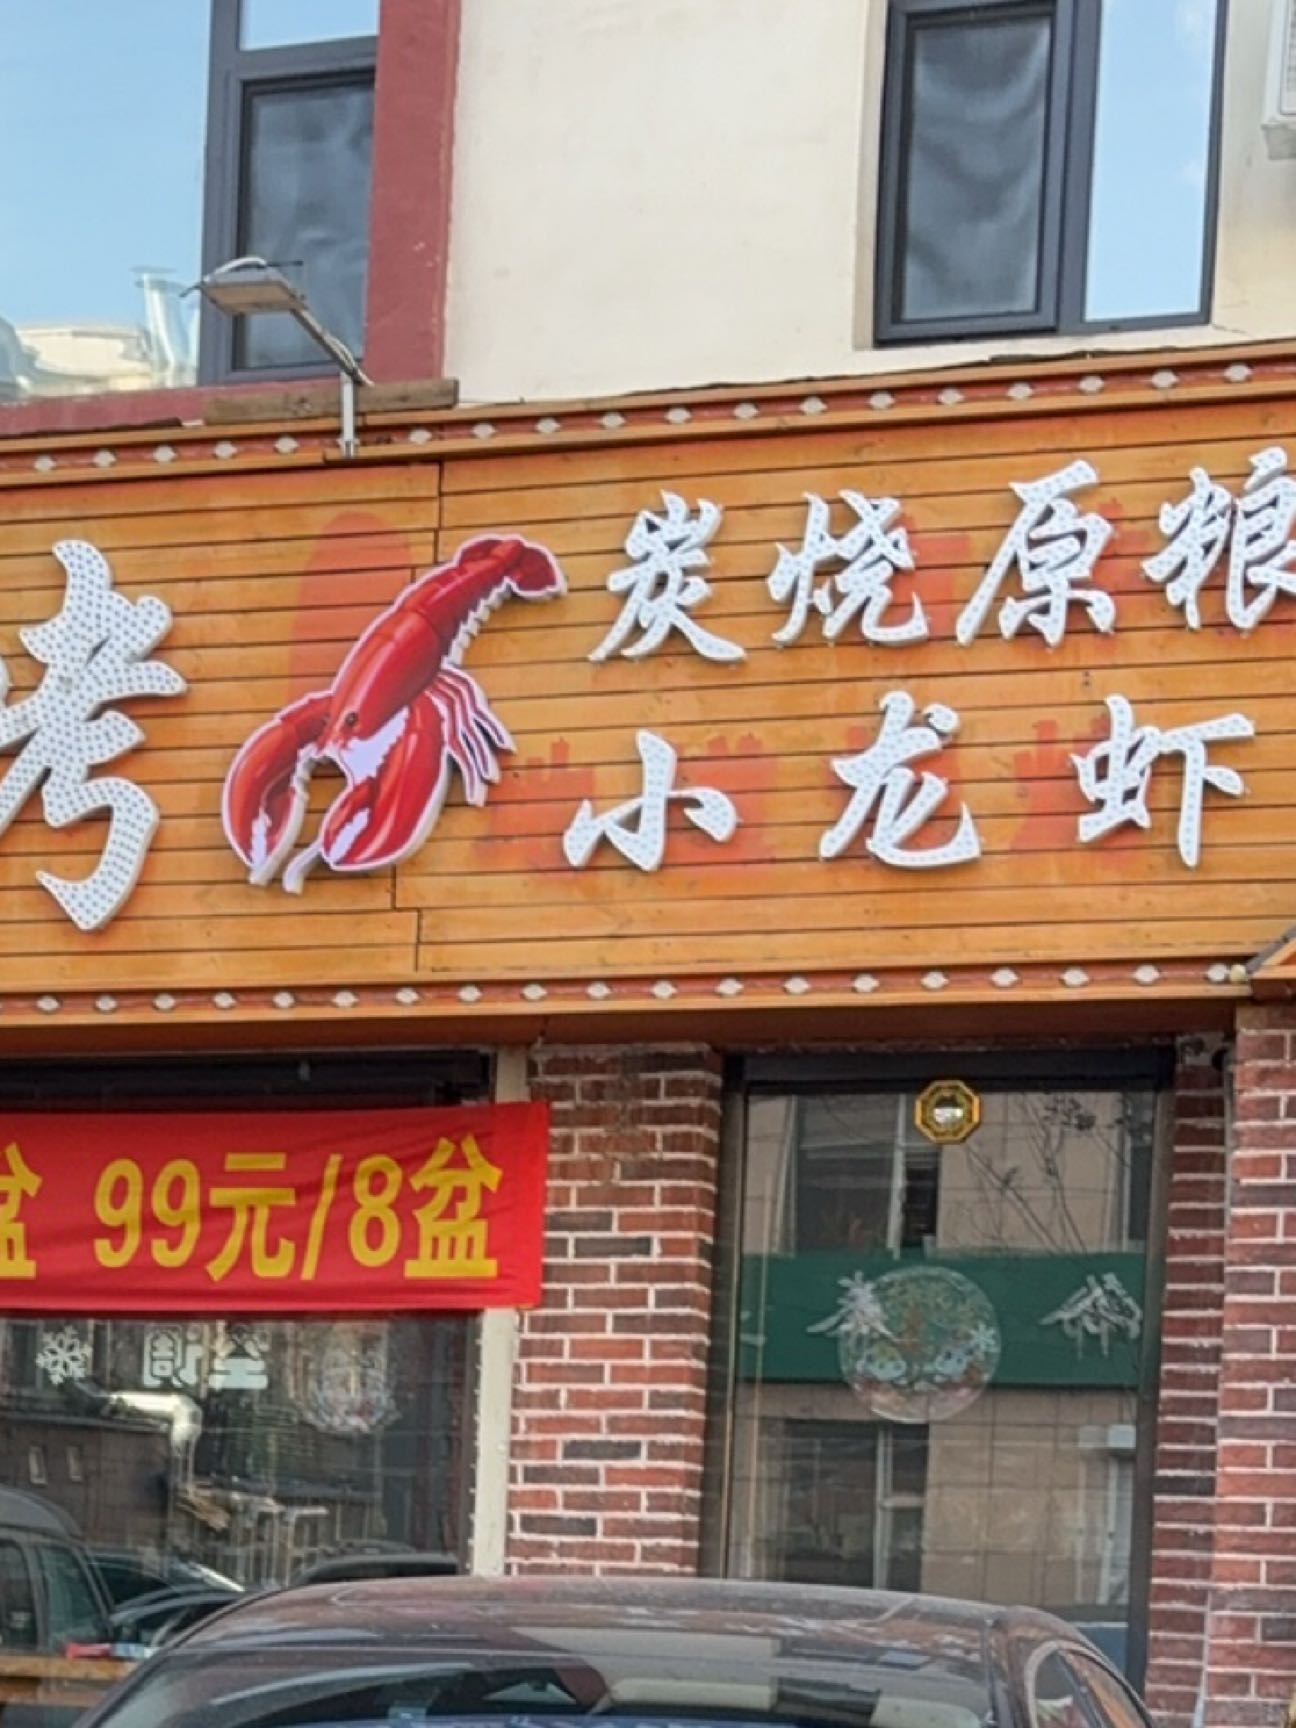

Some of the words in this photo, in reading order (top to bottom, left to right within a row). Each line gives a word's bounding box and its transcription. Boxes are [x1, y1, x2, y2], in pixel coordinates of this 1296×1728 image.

[588, 446, 1296, 662] 炭烧原粮
[563, 691, 1256, 871] 小龙虾
[94, 1135, 503, 1281] 99元/8盆
